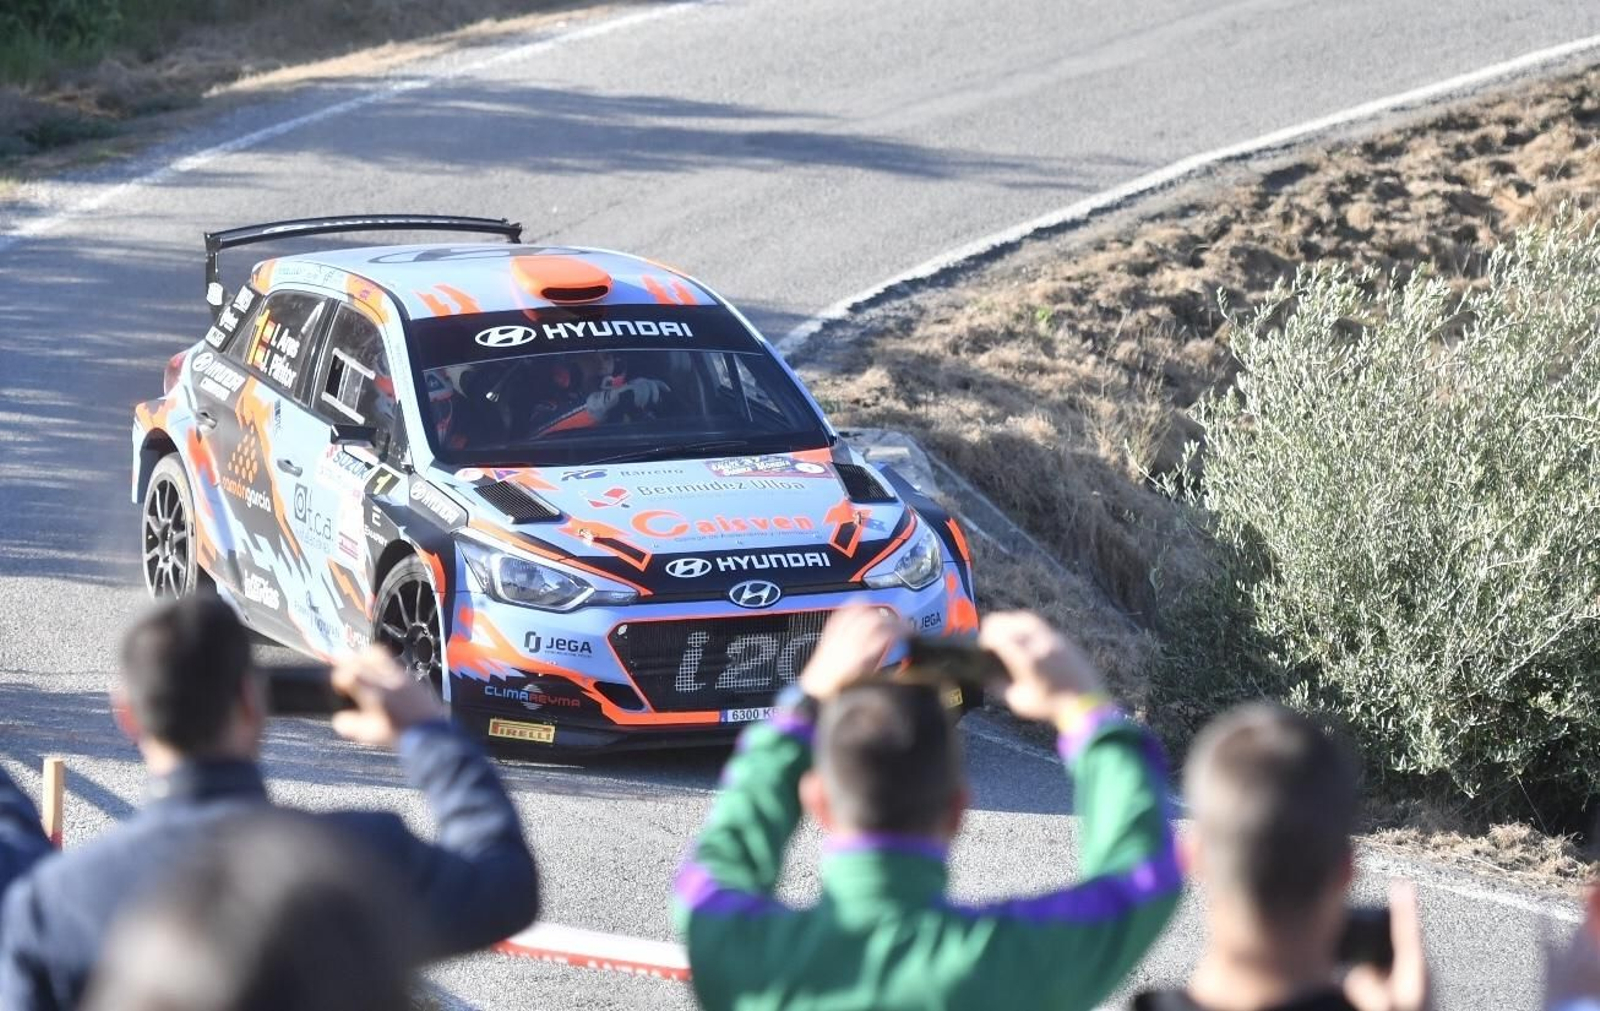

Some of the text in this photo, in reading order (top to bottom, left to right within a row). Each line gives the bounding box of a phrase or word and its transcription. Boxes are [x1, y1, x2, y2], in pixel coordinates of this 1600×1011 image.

[542, 320, 693, 340] HYUNDAI
[372, 473, 393, 495] 1
[716, 552, 831, 571] HYUNDAI
[732, 709, 759, 720] 6300
[491, 721, 553, 740] PIRELLI
